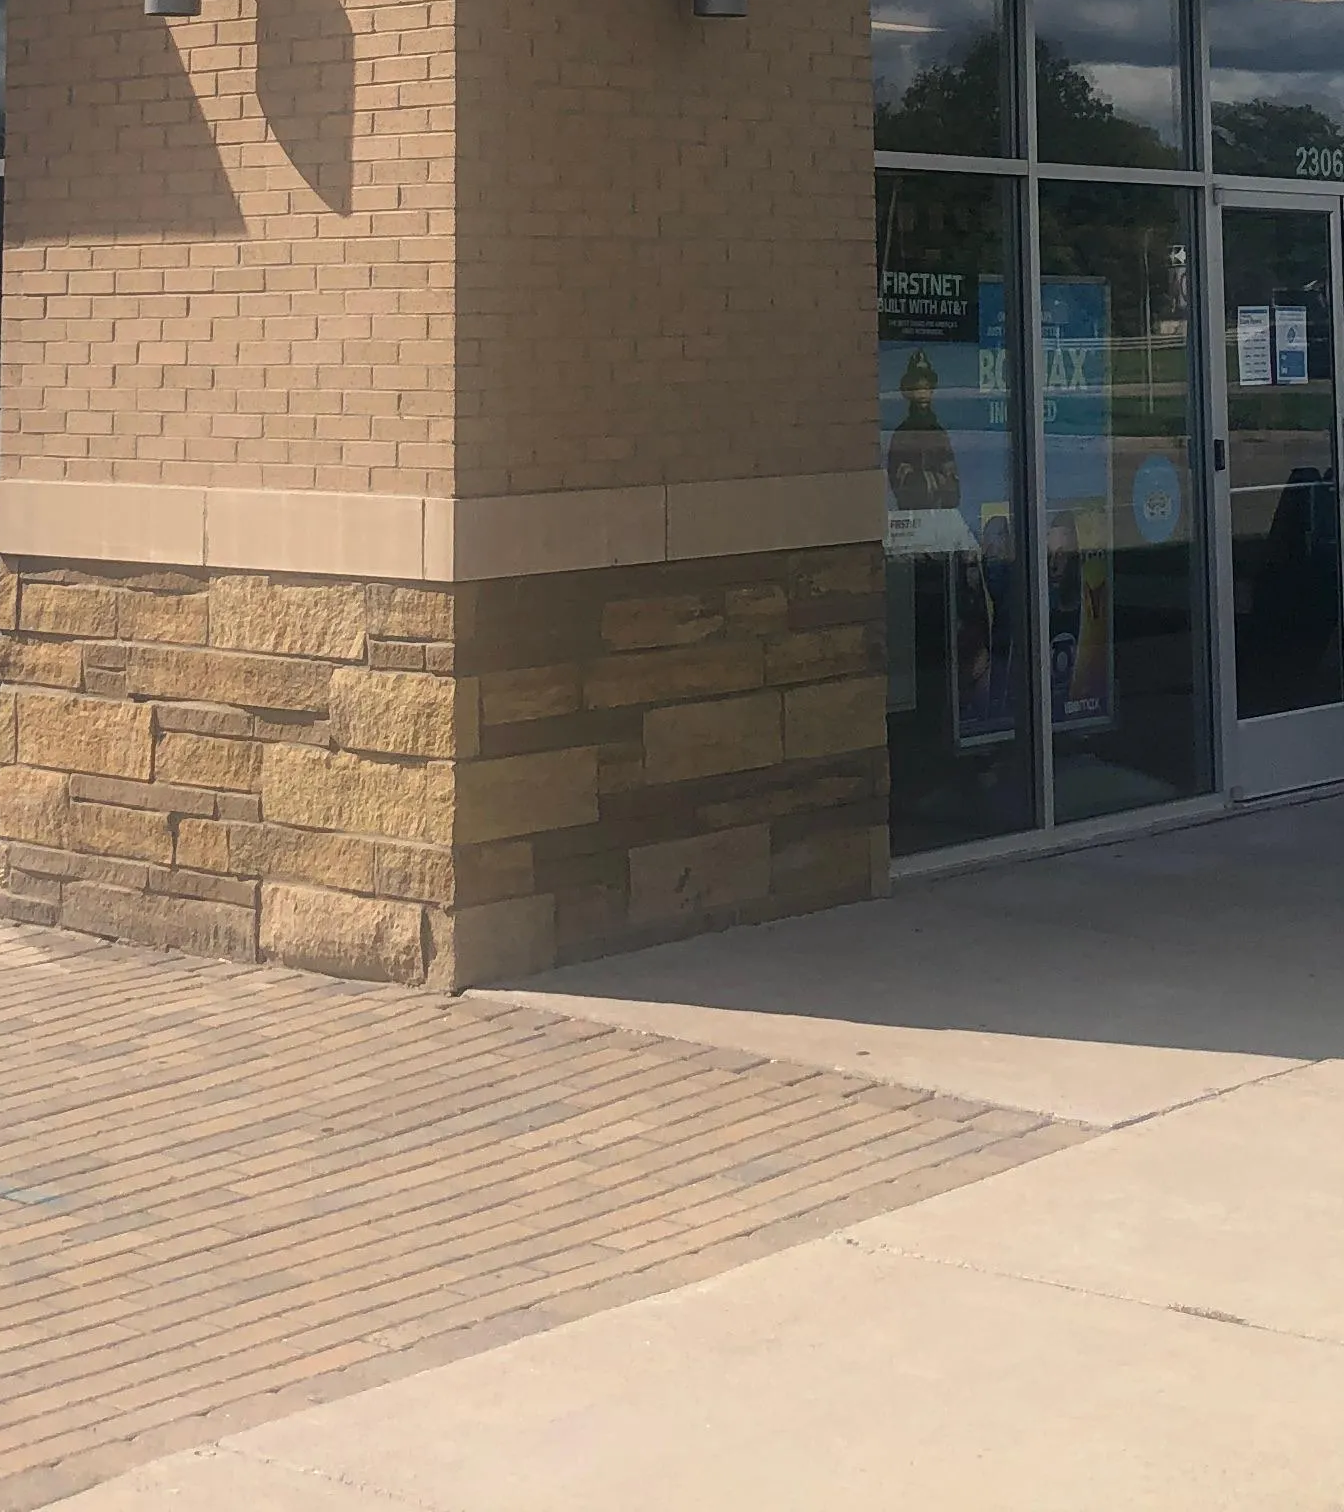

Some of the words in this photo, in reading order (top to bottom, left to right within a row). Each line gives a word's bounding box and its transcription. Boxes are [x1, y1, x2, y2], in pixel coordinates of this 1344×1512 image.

[883, 271, 963, 297] FIRSTNET
[878, 298, 906, 314] BUILT
[909, 299, 937, 315] WITH
[940, 300, 968, 316] AT&T
